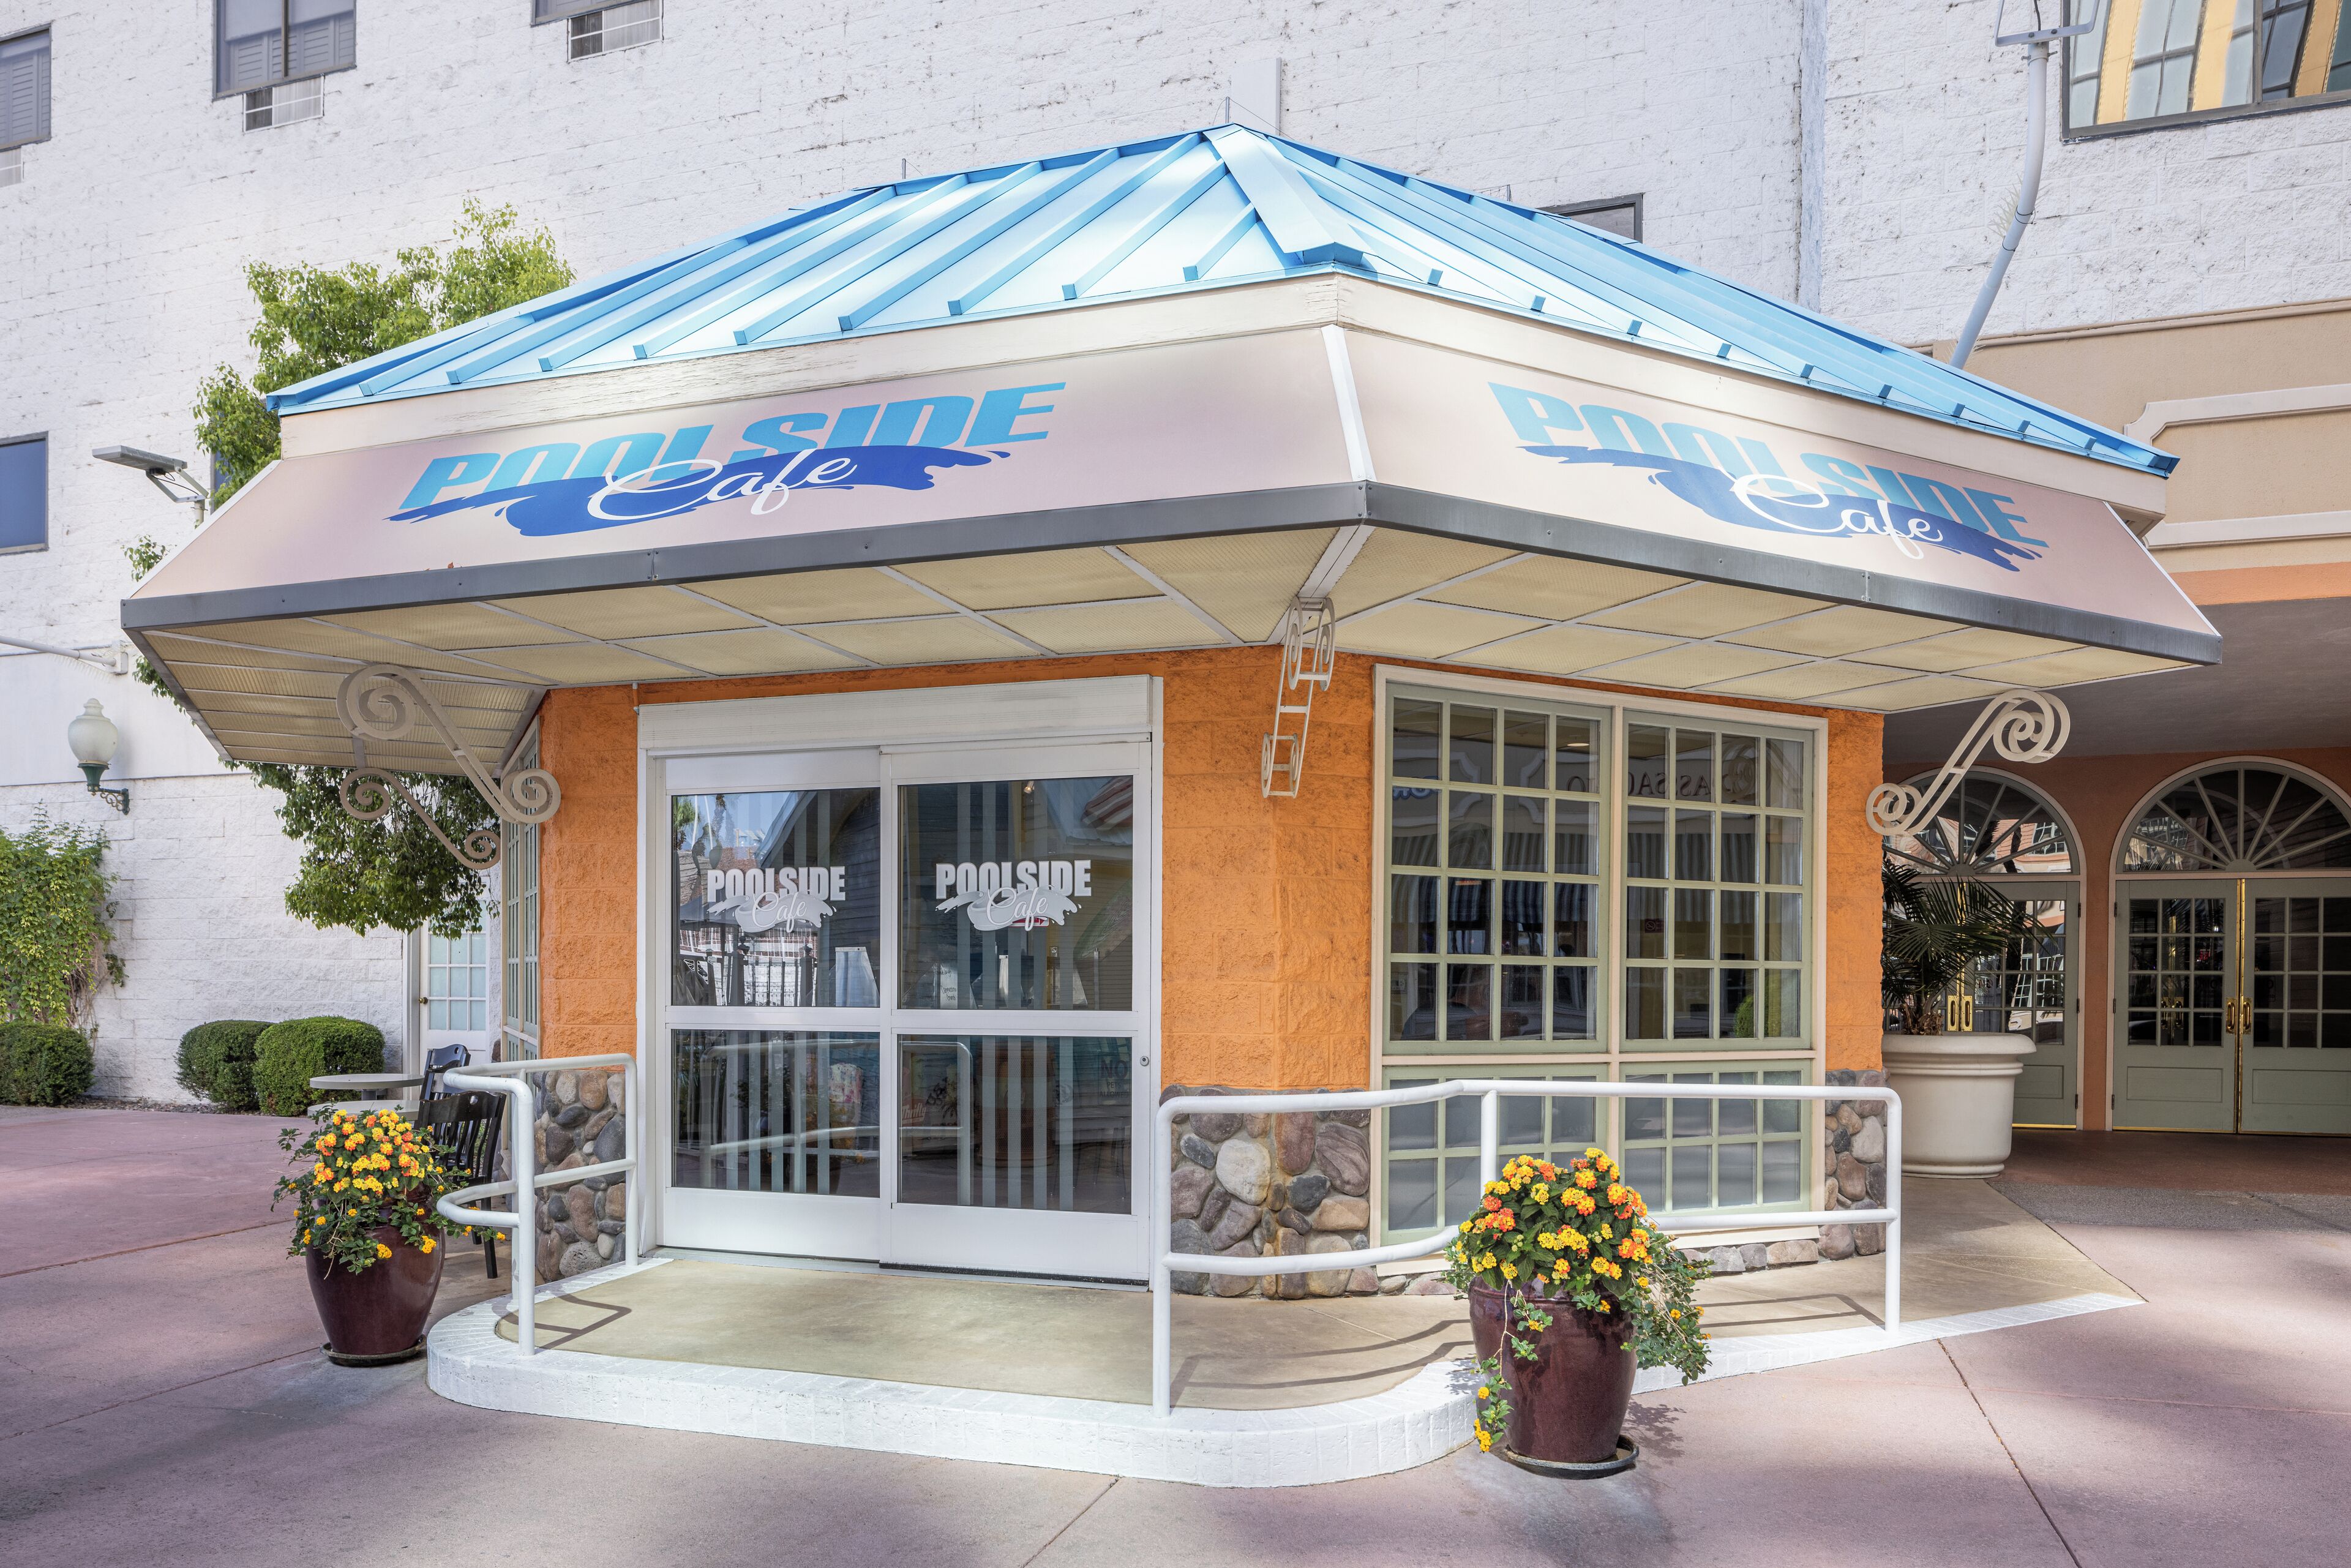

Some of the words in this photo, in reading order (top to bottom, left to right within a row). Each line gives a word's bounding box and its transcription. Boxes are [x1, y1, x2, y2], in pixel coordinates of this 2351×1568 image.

[399, 382, 1066, 509] POOLSIDE
[1487, 382, 2049, 548] POOLSIDE
[587, 449, 857, 520] Cafe
[1718, 467, 1943, 560] Cafe
[707, 866, 846, 902] POOLSIDE
[936, 860, 1091, 899] POOLSIDE
[752, 891, 806, 933] Cafe
[986, 887, 1048, 931] Cafe
[1101, 1060, 1128, 1078] NO
